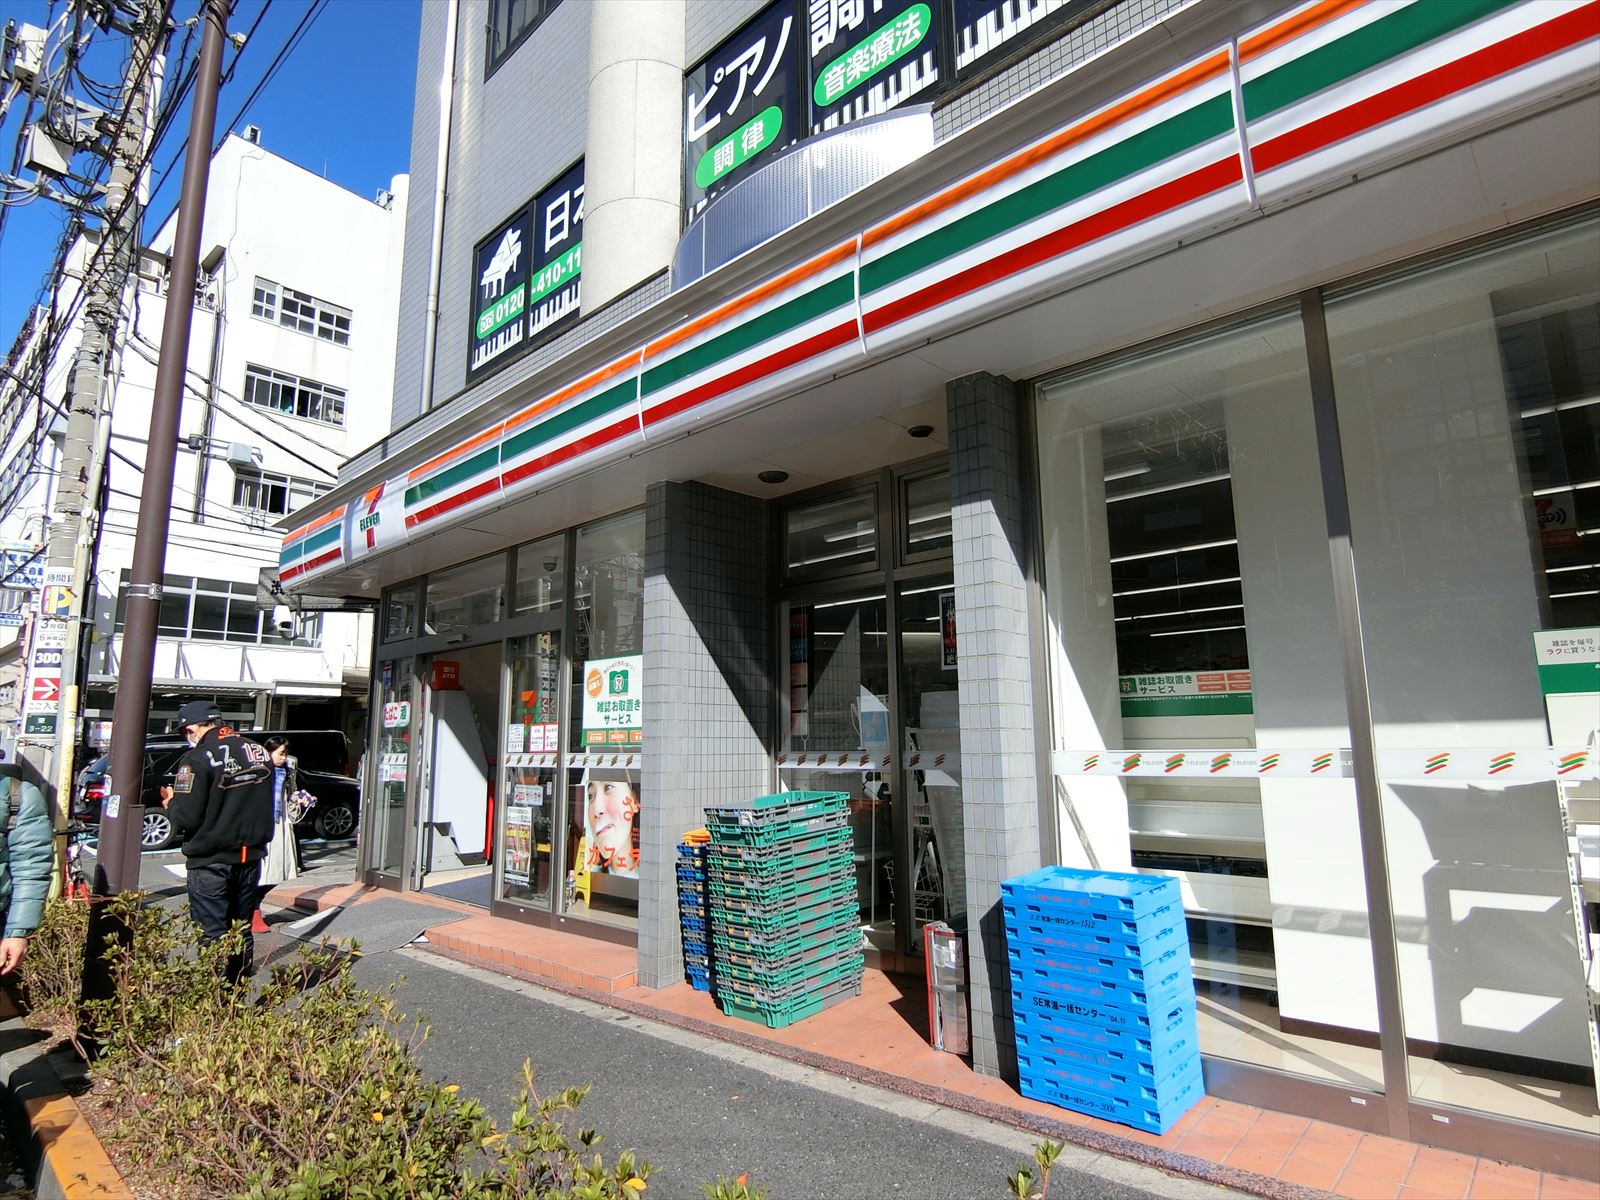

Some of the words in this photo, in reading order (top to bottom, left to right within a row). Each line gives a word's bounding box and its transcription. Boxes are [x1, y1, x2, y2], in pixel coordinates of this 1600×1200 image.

[810, 0, 883, 58] 調
[823, 11, 922, 100] 音楽療法
[689, 16, 793, 142] ピアノ
[713, 120, 765, 176] 調律
[496, 288, 524, 323] 0120
[1138, 674, 1193, 686] 雑誌お取置き
[1140, 685, 1176, 694] サービス
[597, 699, 641, 713] 雑誌お取置き
[604, 714, 632, 725] サービス
[1032, 996, 1106, 1018] SE常温一括センター
